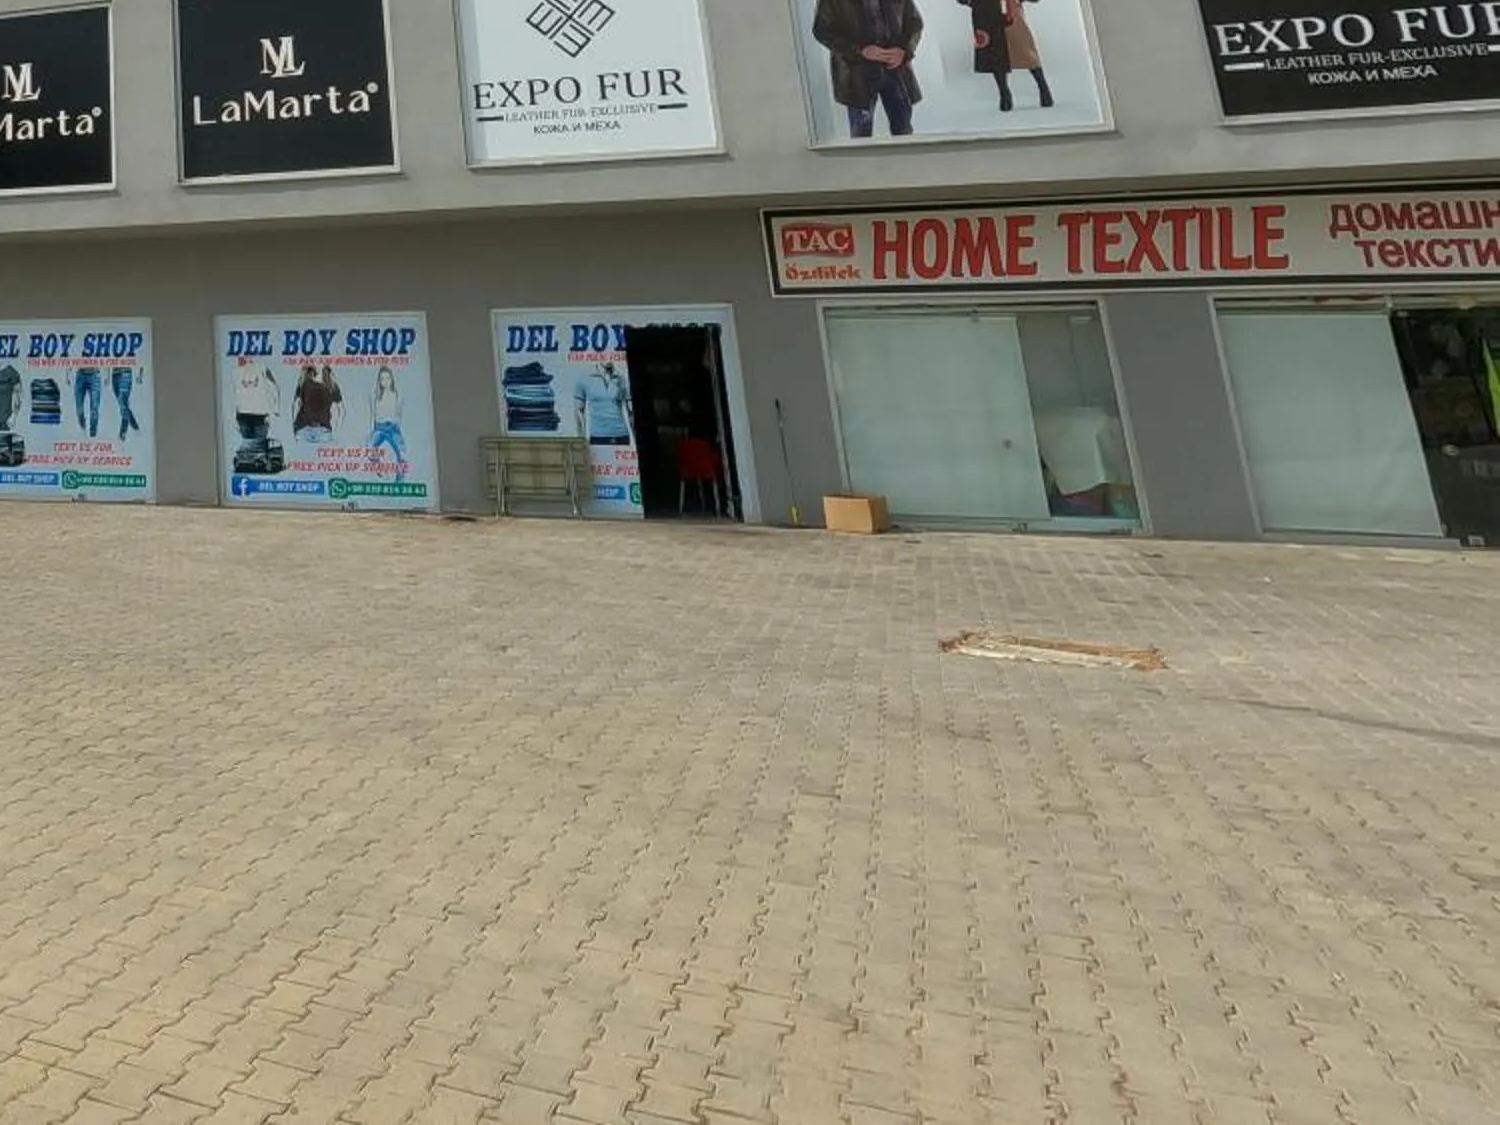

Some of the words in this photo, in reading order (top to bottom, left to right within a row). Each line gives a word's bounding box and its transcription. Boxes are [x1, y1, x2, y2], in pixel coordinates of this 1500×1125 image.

[1214, 14, 1375, 56] EXPO
[1265, 54, 1344, 70] LEATHER
[1308, 70, 1361, 85] КОЖА
[1365, 69, 1380, 81] И
[1382, 64, 1438, 81] МЕХА
[473, 76, 581, 110] EXPO
[598, 68, 687, 100] FUR
[193, 86, 371, 125] LaMarta
[505, 110, 559, 123] LEATHER
[872, 215, 1038, 279] HOME
[1058, 205, 1289, 274] TEXTILE
[28, 334, 74, 358] BOY
[82, 332, 143, 357] SHOP
[227, 330, 273, 356] DEL
[282, 329, 337, 356] BOY
[346, 327, 416, 355] SHOP
[506, 325, 559, 352] DEL
